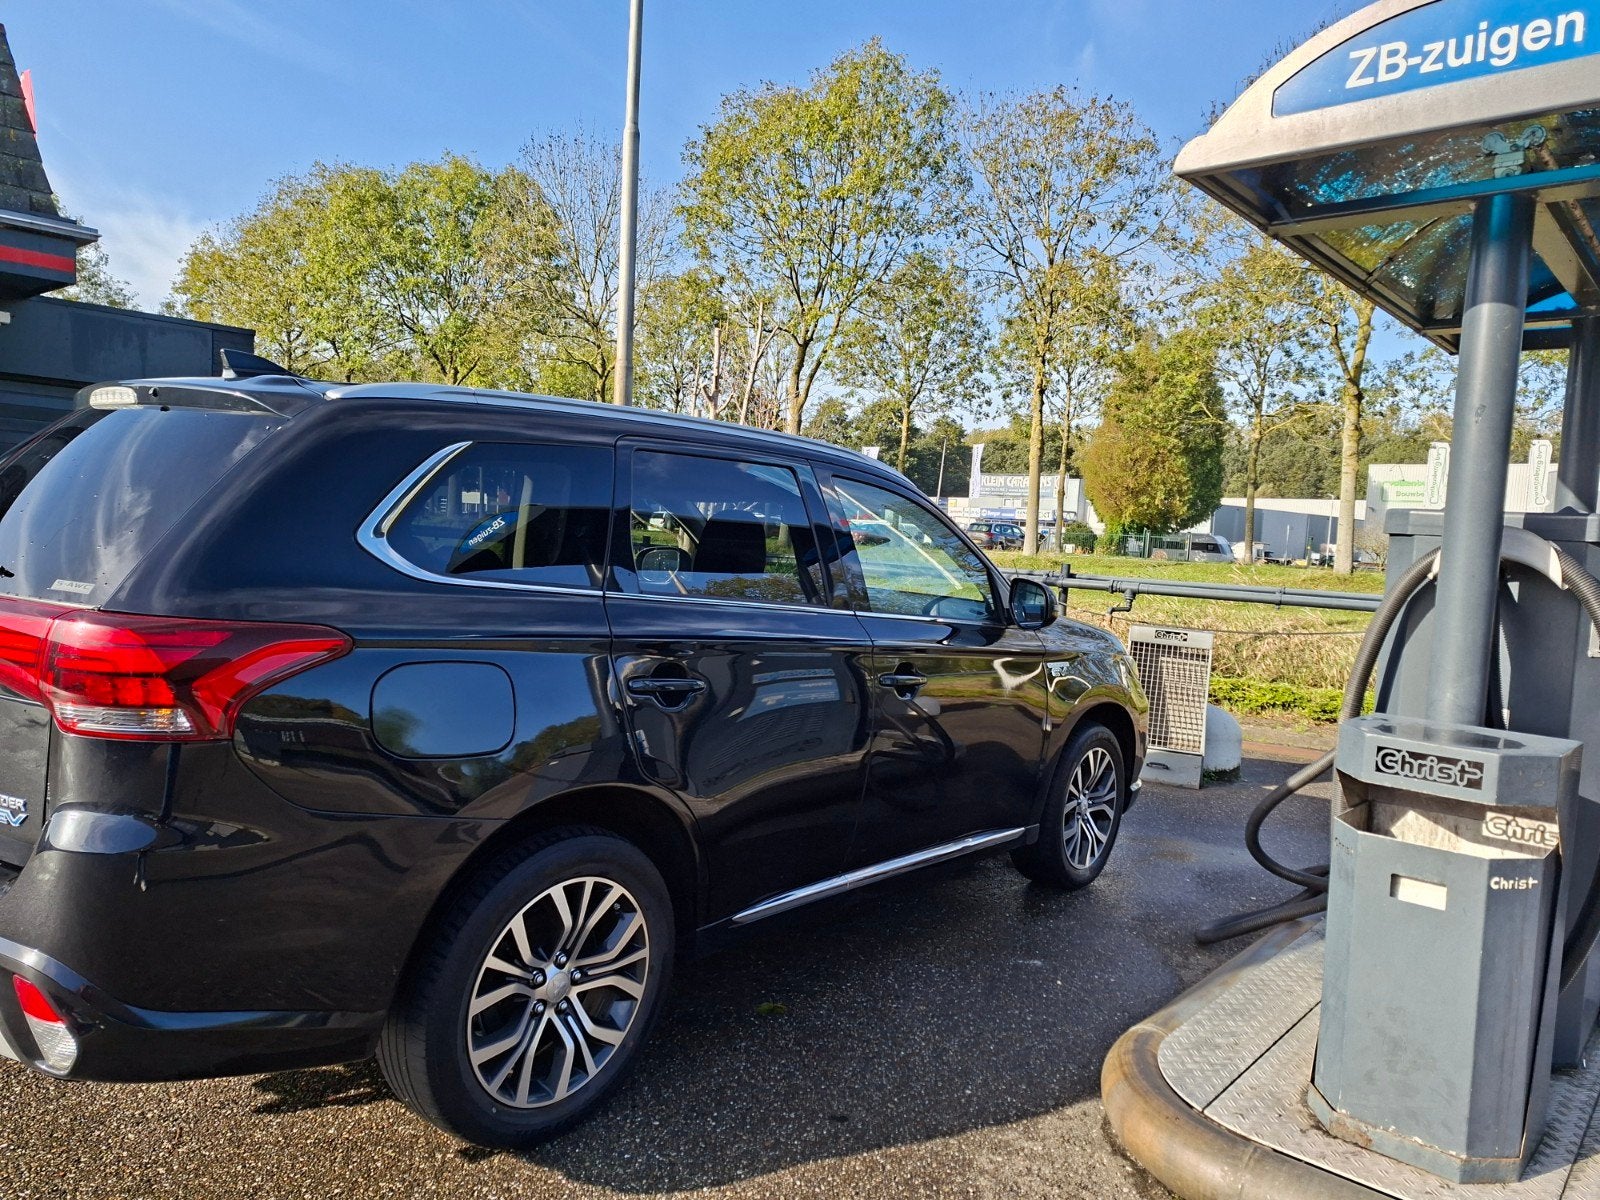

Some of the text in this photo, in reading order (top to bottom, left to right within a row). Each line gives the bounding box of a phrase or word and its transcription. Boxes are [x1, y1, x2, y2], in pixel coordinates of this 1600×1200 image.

[1345, 11, 1585, 89] ZB-zuigen
[981, 475, 1051, 488] KLEIN CARANS
[1155, 630, 1188, 641] Christ
[1375, 748, 1484, 788] Christ
[1490, 876, 1539, 890] Christ
